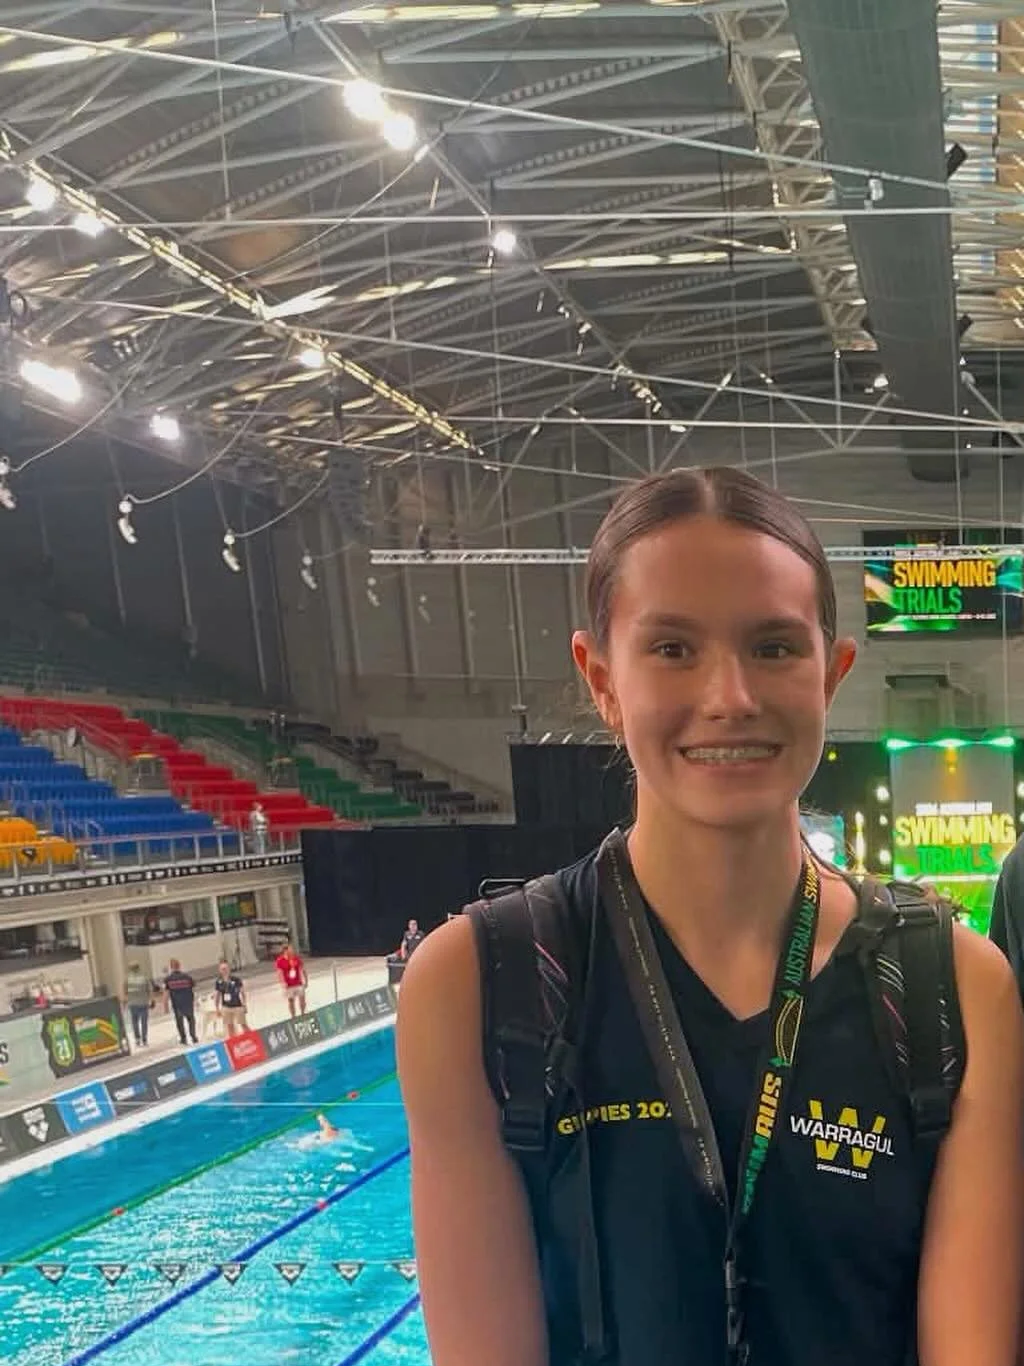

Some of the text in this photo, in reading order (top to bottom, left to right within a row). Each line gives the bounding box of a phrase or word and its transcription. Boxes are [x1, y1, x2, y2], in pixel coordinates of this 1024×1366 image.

[894, 560, 997, 588] SWIMMING
[894, 587, 962, 614] TRIALS
[895, 814, 1017, 846] SWIMMING
[916, 844, 994, 875] TRIALS
[790, 1115, 895, 1156] WARRAGUL
